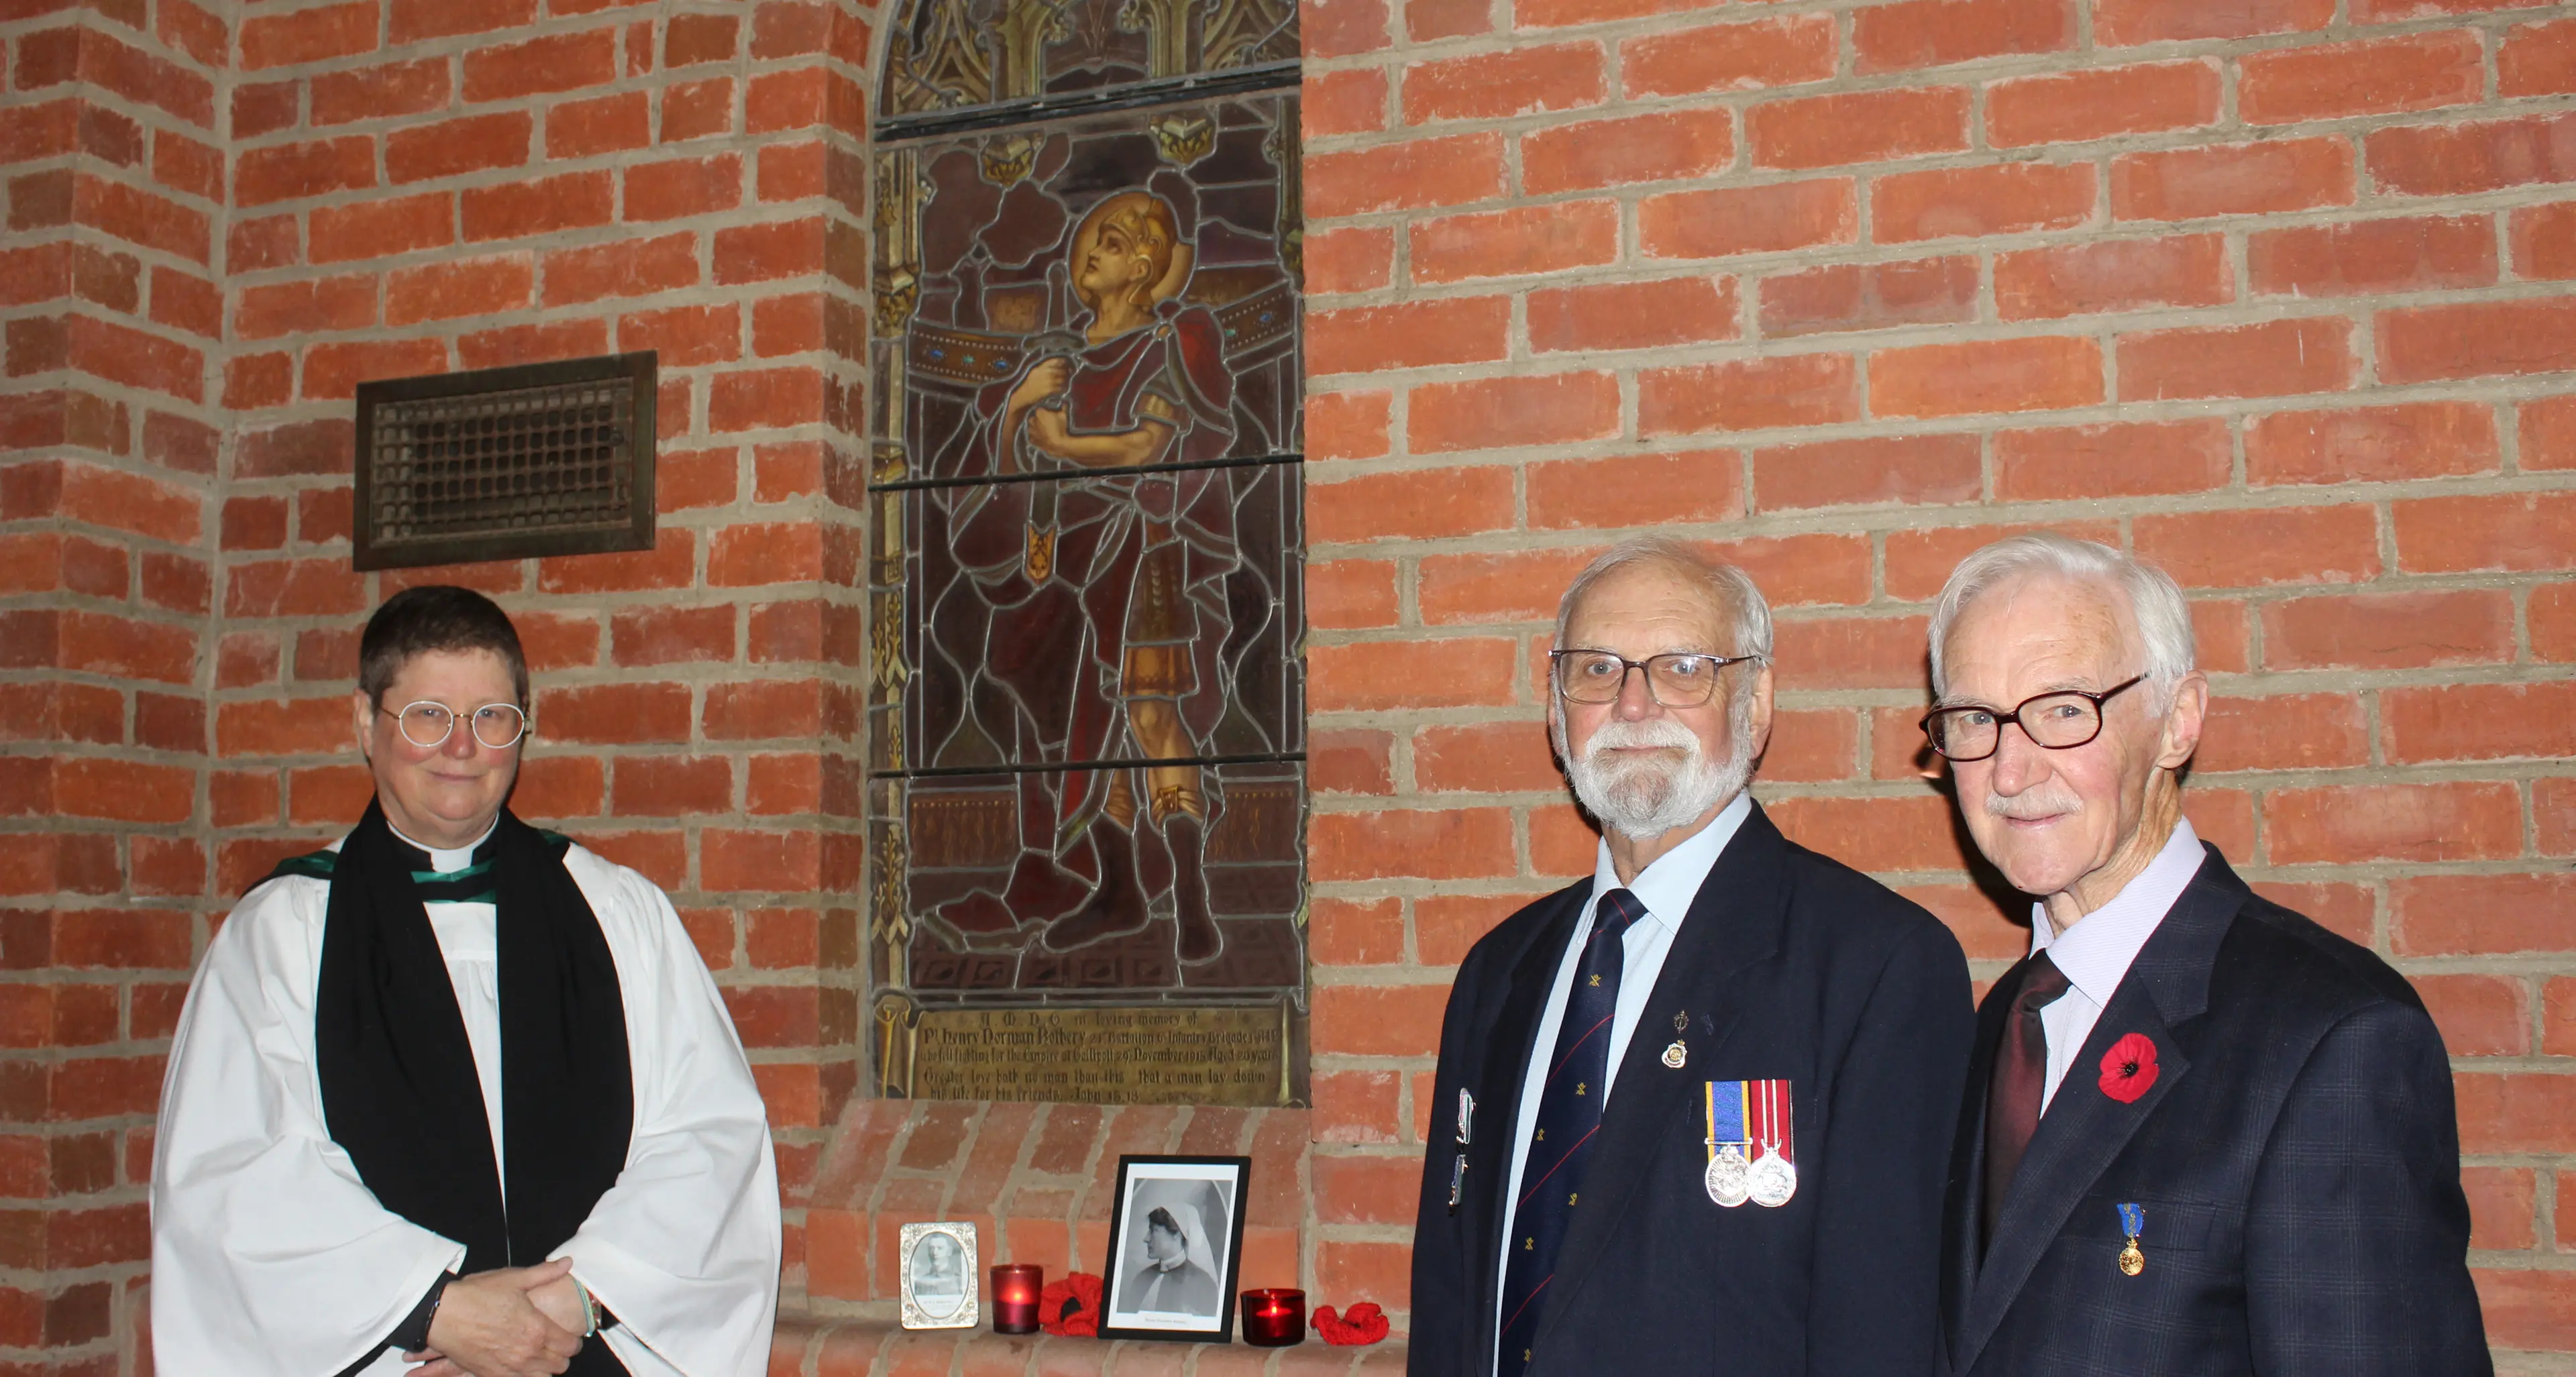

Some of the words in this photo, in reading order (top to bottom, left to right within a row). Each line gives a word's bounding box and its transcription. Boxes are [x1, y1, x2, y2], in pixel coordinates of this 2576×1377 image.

[1096, 1011, 1133, 1028] loving
[1138, 1014, 1181, 1027] memory
[1187, 1010, 1197, 1027] of
[1168, 1030, 1208, 1046] Infantry
[1209, 1030, 1250, 1045] Brigade
[938, 1046, 953, 1063] fell
[955, 1046, 989, 1065] fighting
[991, 1046, 1005, 1065] for
[1007, 1047, 1020, 1062] the
[1023, 1046, 1061, 1065] Empire
[1062, 1049, 1071, 1062] at
[1073, 1046, 1115, 1067] Gallipoli
[1133, 1046, 1186, 1063] November
[1209, 1046, 1235, 1065] Aged
[1238, 1050, 1250, 1061] 20
[924, 1066, 964, 1087] Greater
[971, 1068, 992, 1085] love
[996, 1068, 1018, 1085] hath
[1025, 1072, 1040, 1084] no
[1043, 1071, 1069, 1085] man
[1074, 1068, 1099, 1085] than
[1104, 1068, 1125, 1085] this
[1138, 1068, 1161, 1085] that
[1164, 1072, 1173, 1084] a
[1176, 1071, 1203, 1085] man
[1208, 1066, 1228, 1085] lay
[1233, 1068, 1267, 1084] down
[930, 1085, 947, 1101] his
[953, 1085, 970, 1101] life
[974, 1085, 991, 1101] for
[996, 1086, 1012, 1101] his
[1071, 1086, 1102, 1103] John
